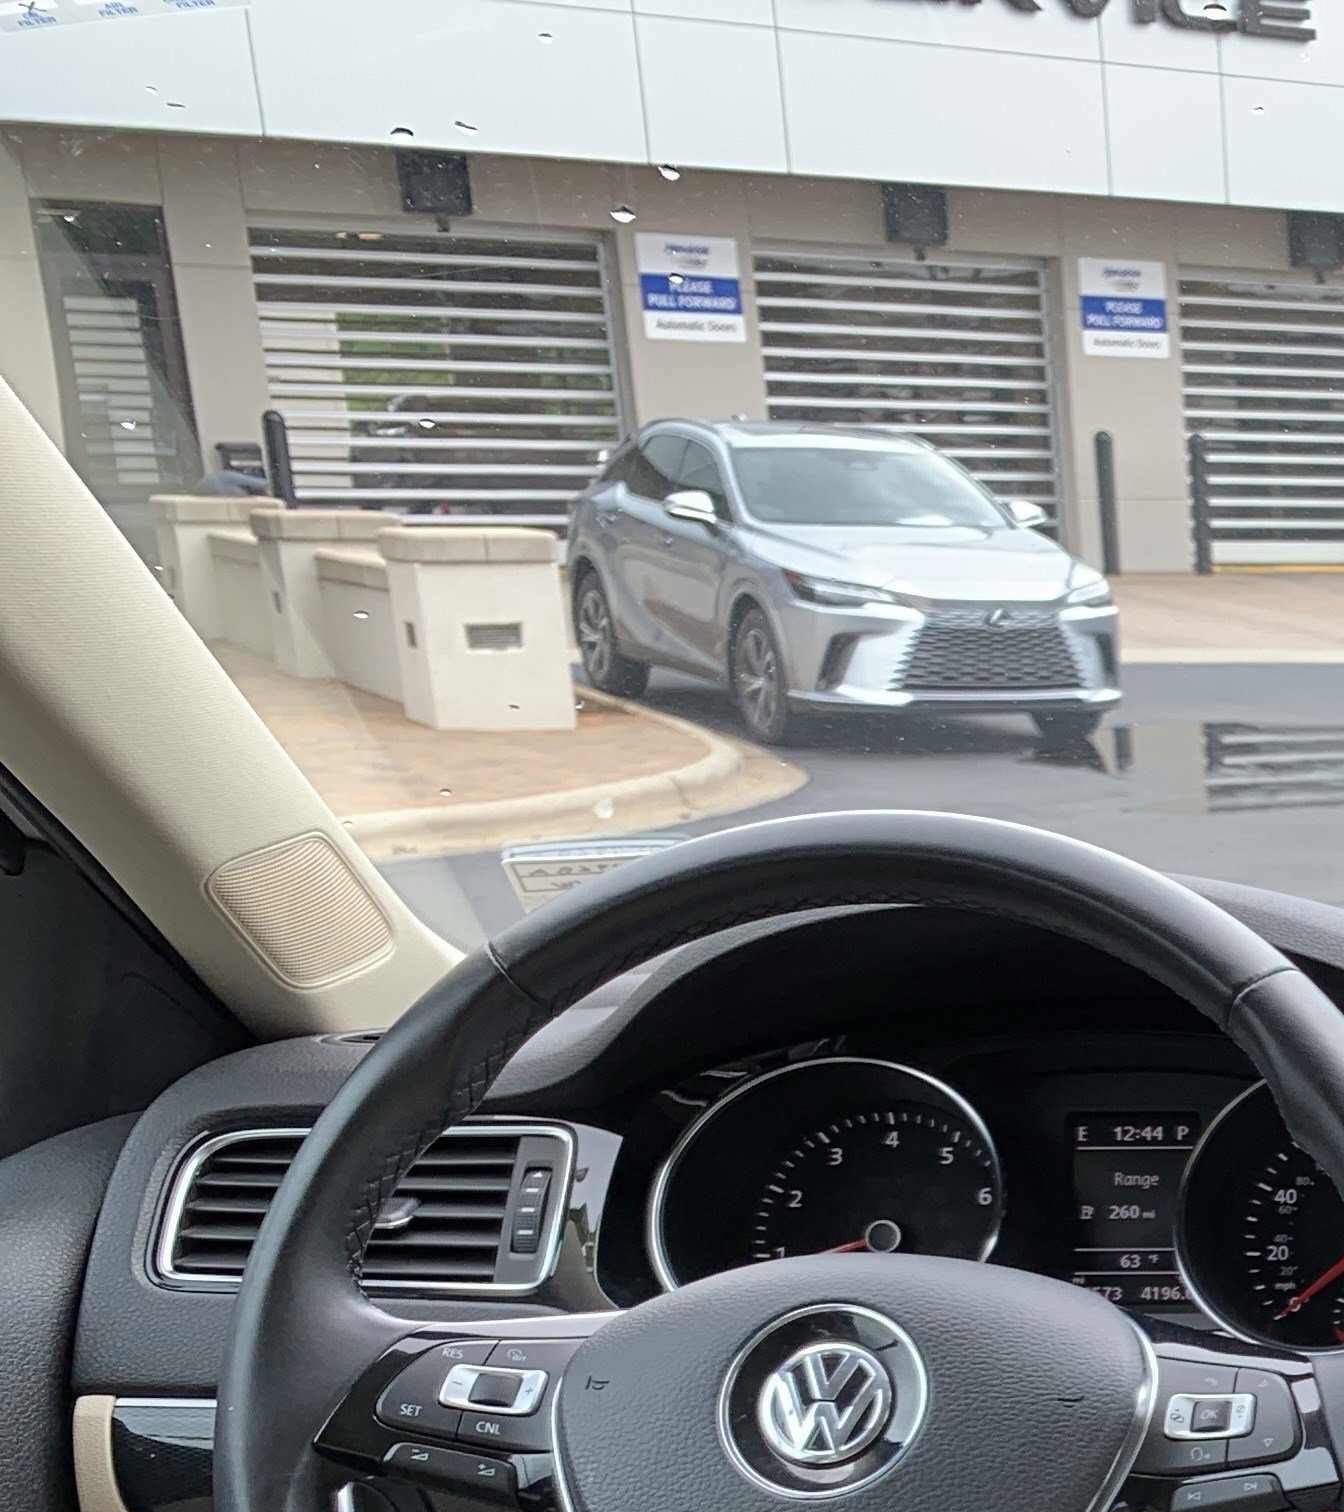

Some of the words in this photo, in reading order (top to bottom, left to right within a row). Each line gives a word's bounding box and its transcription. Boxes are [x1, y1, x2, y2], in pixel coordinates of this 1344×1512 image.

[885, 1131, 900, 1148] 4
[1077, 1126, 1088, 1141] E
[1113, 1126, 1163, 1141] 12:44
[1176, 1126, 1189, 1141] P
[828, 1148, 843, 1165] 3
[939, 1147, 954, 1165] 5
[1114, 1171, 1160, 1189] Range
[787, 1190, 802, 1208] 2
[977, 1188, 992, 1206] 6
[1274, 1189, 1297, 1204] 40
[1109, 1205, 1140, 1219] 260
[1120, 1254, 1141, 1268] 63
[1266, 1246, 1289, 1261] 20
[442, 1347, 463, 1359] RES
[400, 1403, 422, 1416] SET
[1201, 1410, 1218, 1419] OK
[476, 1421, 501, 1434] CNL
